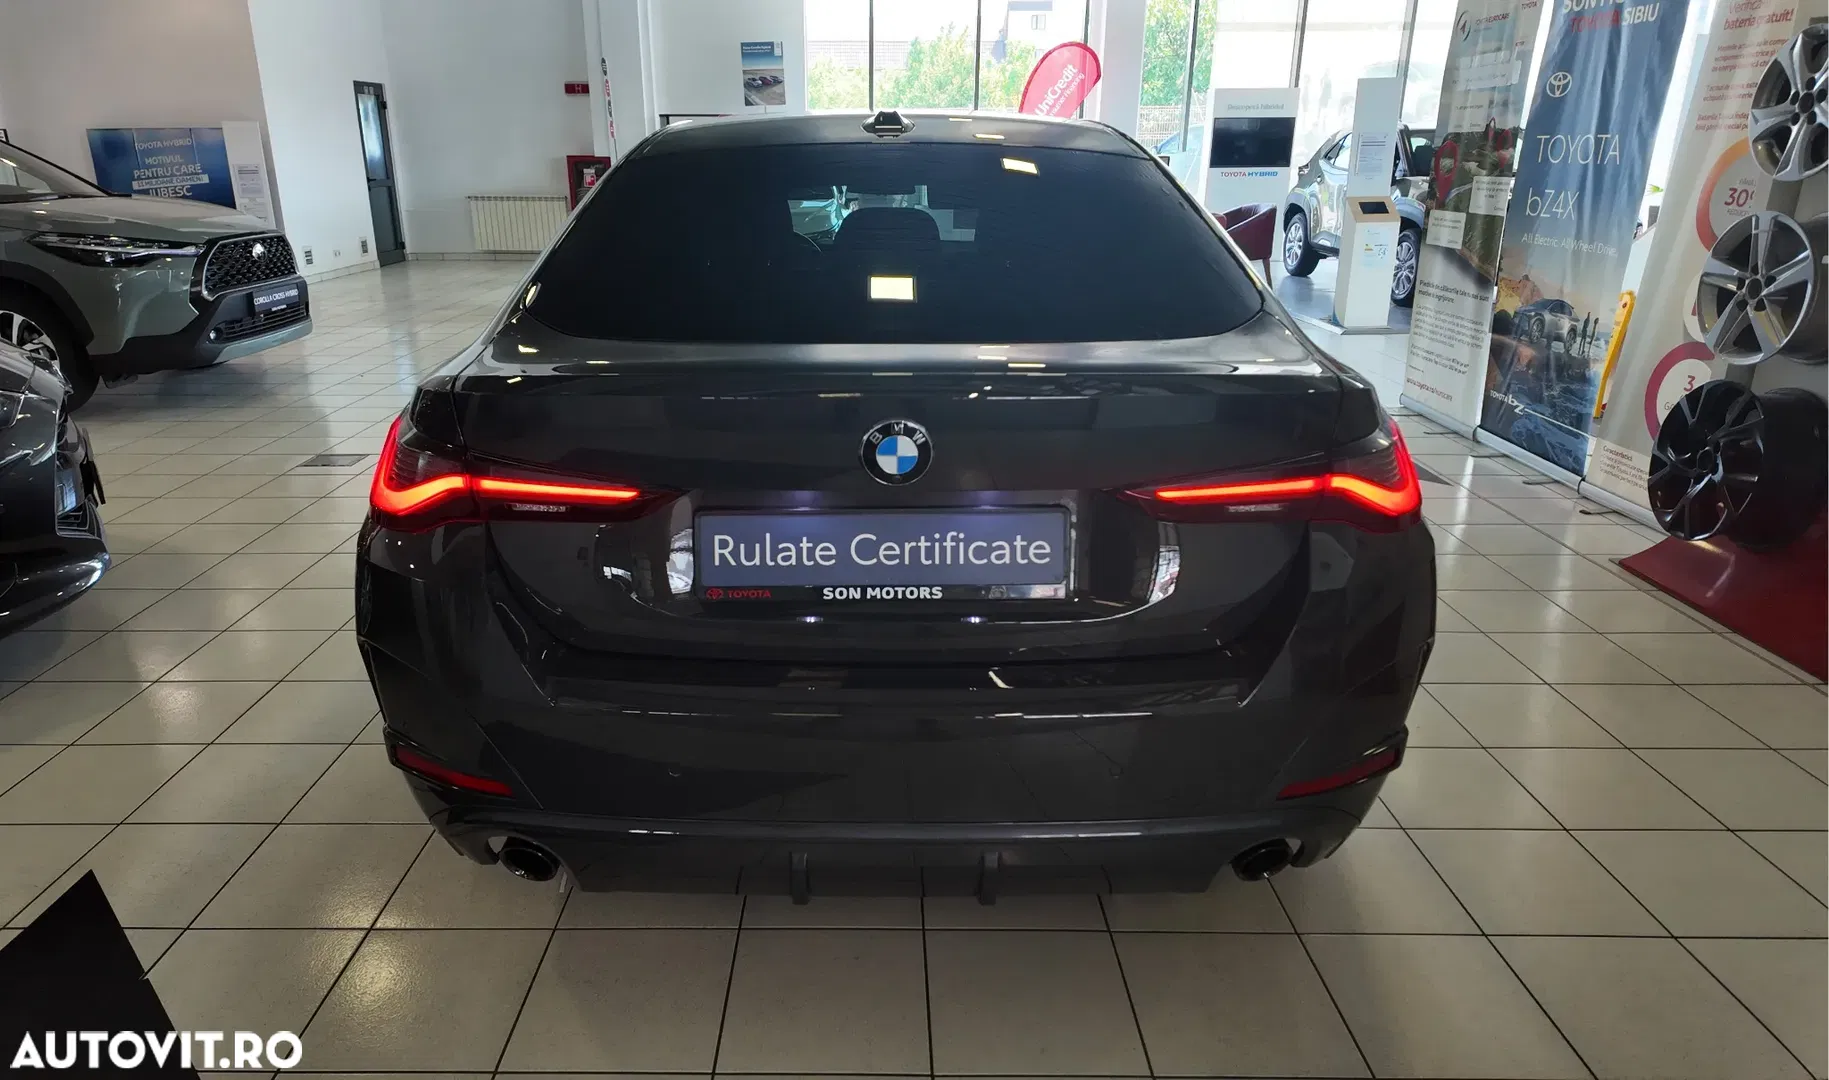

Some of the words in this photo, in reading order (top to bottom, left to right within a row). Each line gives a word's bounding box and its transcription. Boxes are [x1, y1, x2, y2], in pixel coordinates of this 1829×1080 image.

[1570, 9, 1620, 32] TOYOTA
[1621, 3, 1660, 26] SIBIU
[1723, 15, 1757, 30] bateria
[1034, 64, 1078, 116] UniCredit
[135, 141, 163, 150] TOYOTA
[162, 138, 192, 147] HYBRID
[1536, 134, 1620, 166] TOYOTA
[144, 154, 184, 165] MOTIVUL
[133, 166, 172, 179] PENTRU
[173, 164, 203, 175] CARE
[1525, 187, 1580, 221] bZ4X
[272, 291, 286, 301] CROSS
[1490, 389, 1508, 403] TOYOTA
[713, 532, 837, 566] Rulate
[850, 531, 1052, 566] Certificate
[727, 590, 772, 599] TOYOTA
[822, 587, 863, 600] SON
[866, 586, 943, 600] MOTORS
